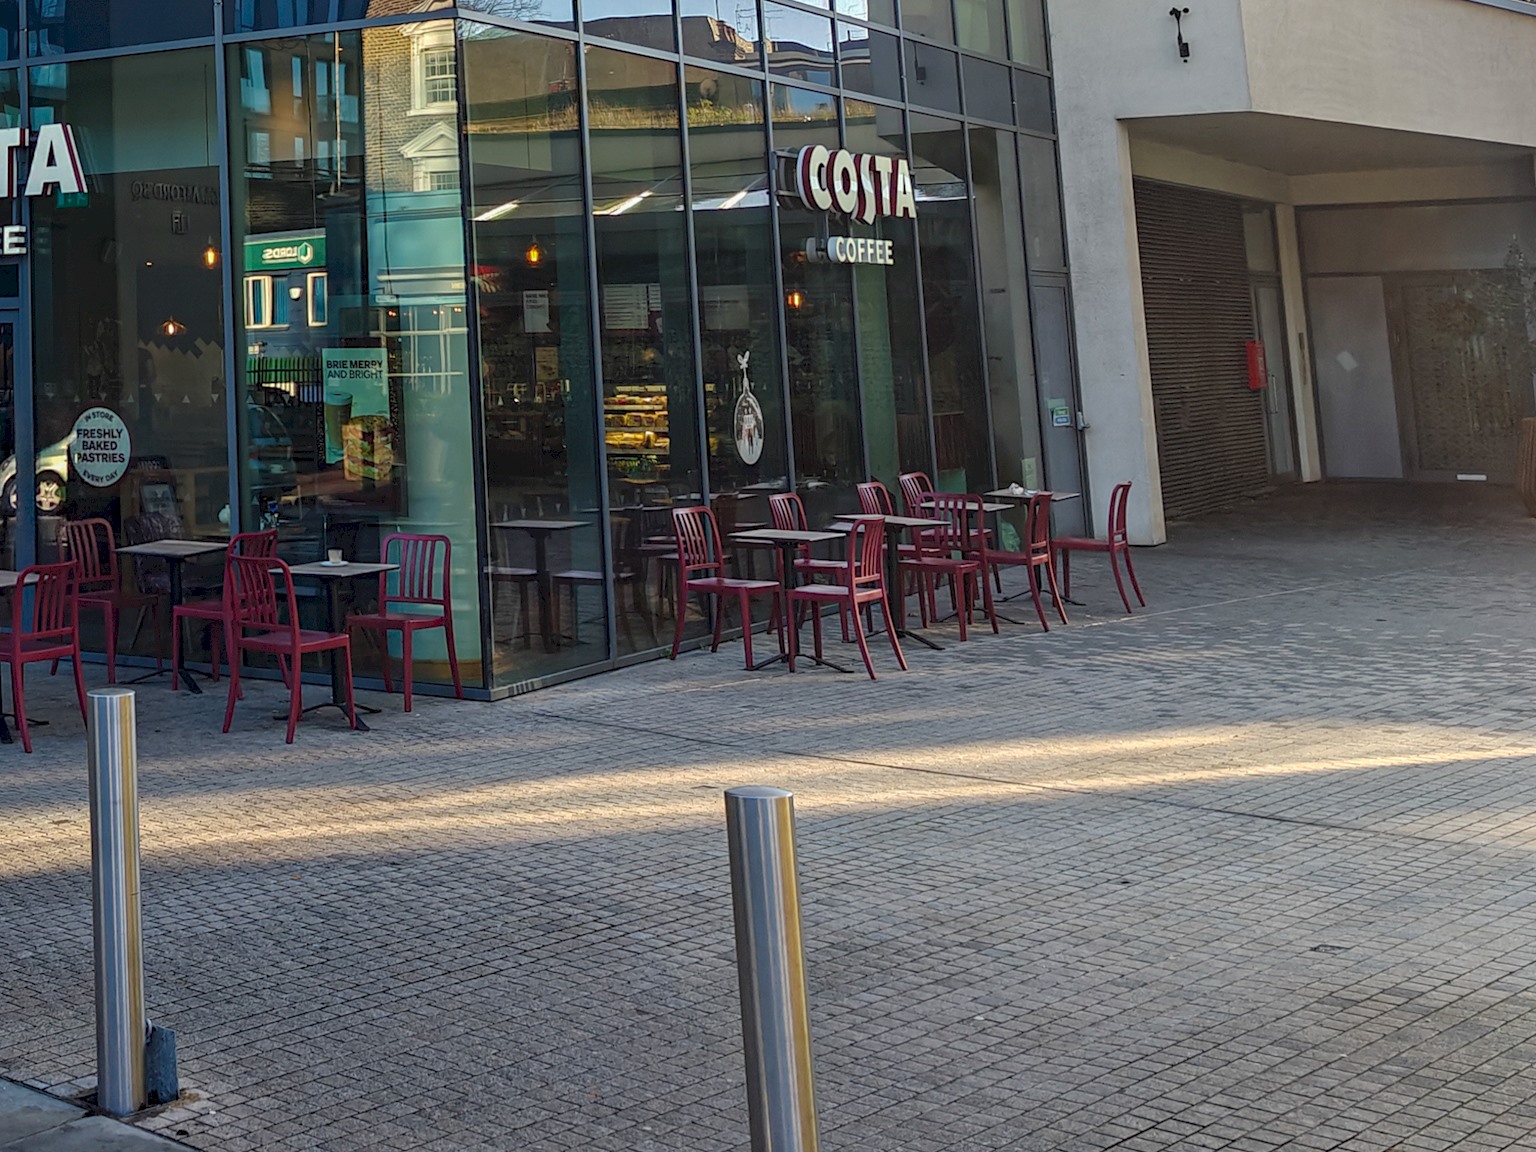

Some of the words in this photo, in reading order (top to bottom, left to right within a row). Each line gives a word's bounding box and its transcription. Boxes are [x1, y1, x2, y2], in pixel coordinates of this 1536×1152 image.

[797, 144, 917, 225] COSTA
[828, 236, 894, 265] COFFEE
[326, 360, 348, 369] BRIE
[349, 360, 383, 369] MERRY
[327, 369, 348, 379] AND
[349, 369, 383, 379] BRIGHT
[91, 411, 114, 422] STORE
[76, 429, 123, 439] FRESHLY
[82, 440, 118, 451] BAKED
[76, 453, 125, 463] PASTRIES
[83, 469, 104, 482] EVERY
[105, 470, 118, 482] DAY
